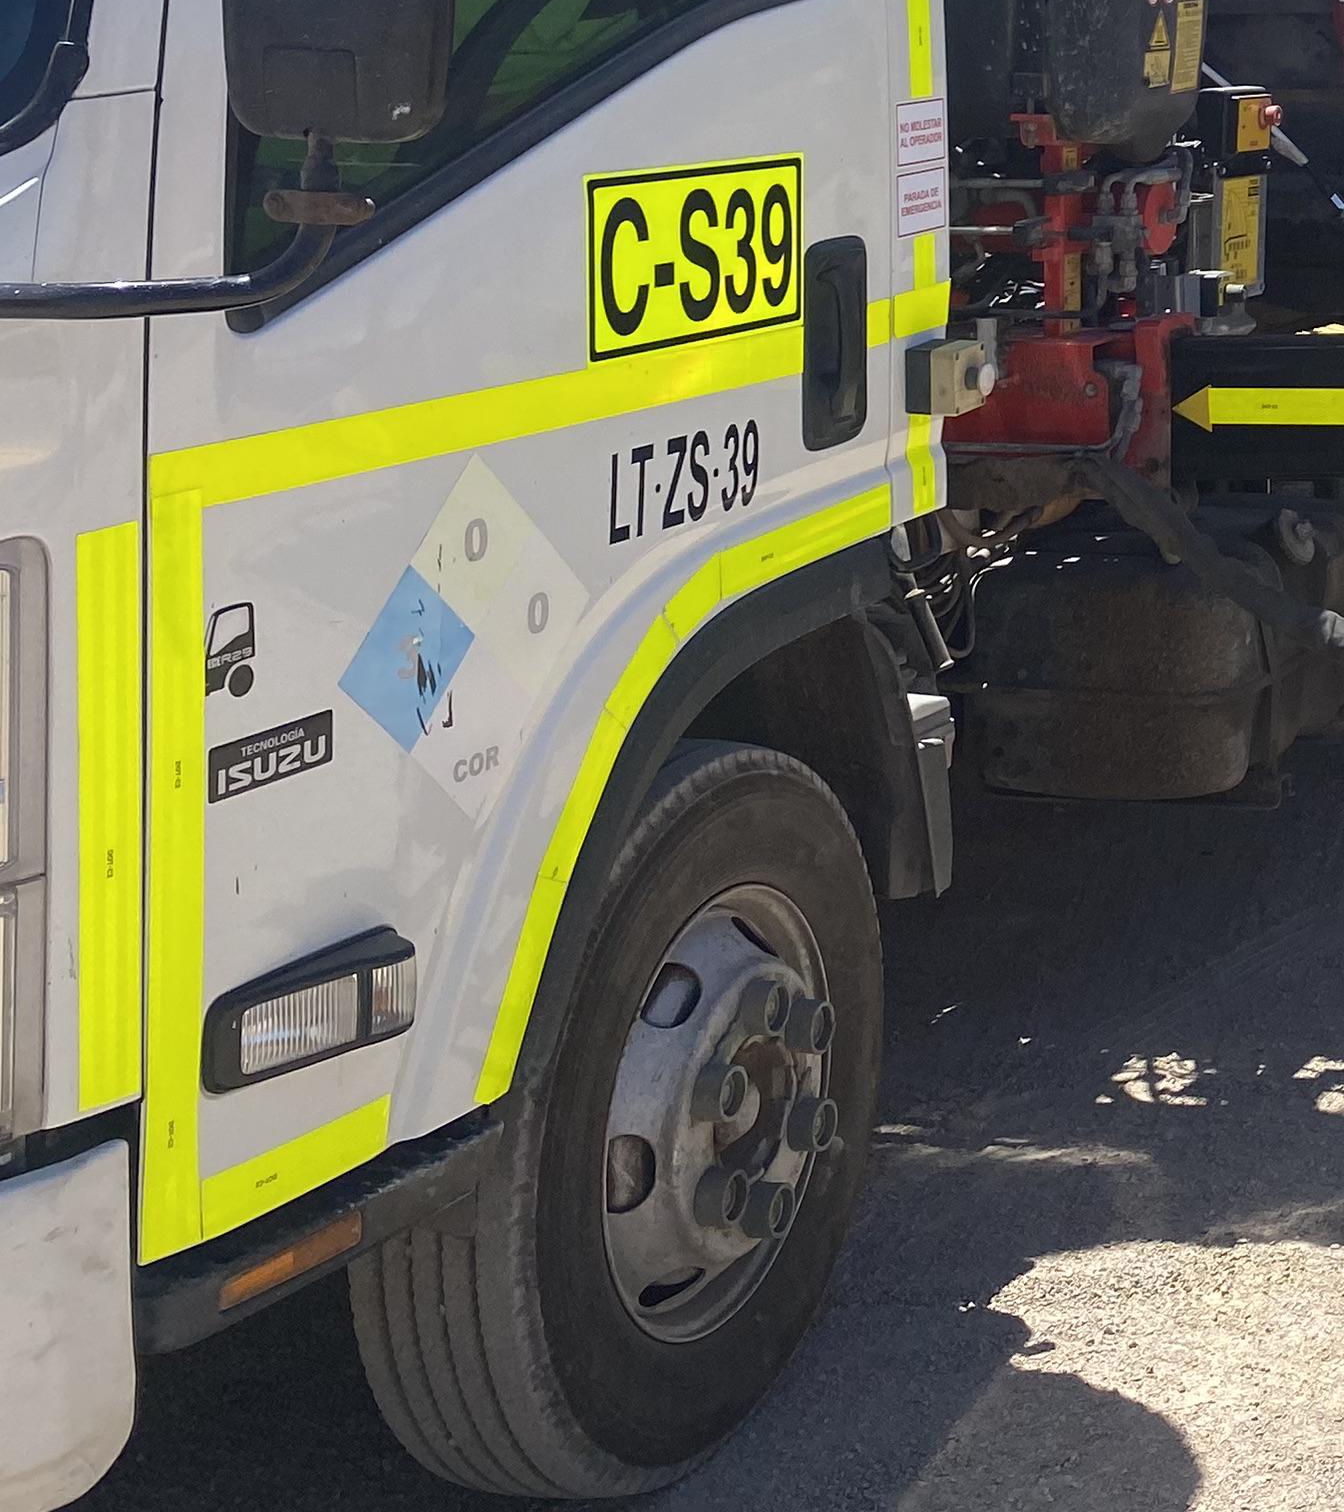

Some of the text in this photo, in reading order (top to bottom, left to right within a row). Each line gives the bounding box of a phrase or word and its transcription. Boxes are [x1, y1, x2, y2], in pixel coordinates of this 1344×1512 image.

[900, 122, 909, 134] NO
[900, 131, 942, 148] AL OPERADOR
[903, 187, 939, 203] PARADA DE
[901, 200, 942, 217] EMERGENCIA
[600, 183, 792, 336] C-S39
[240, 727, 305, 758] TECNOLOGÍA
[217, 734, 326, 796] ISUZU
[453, 745, 500, 783] COR
